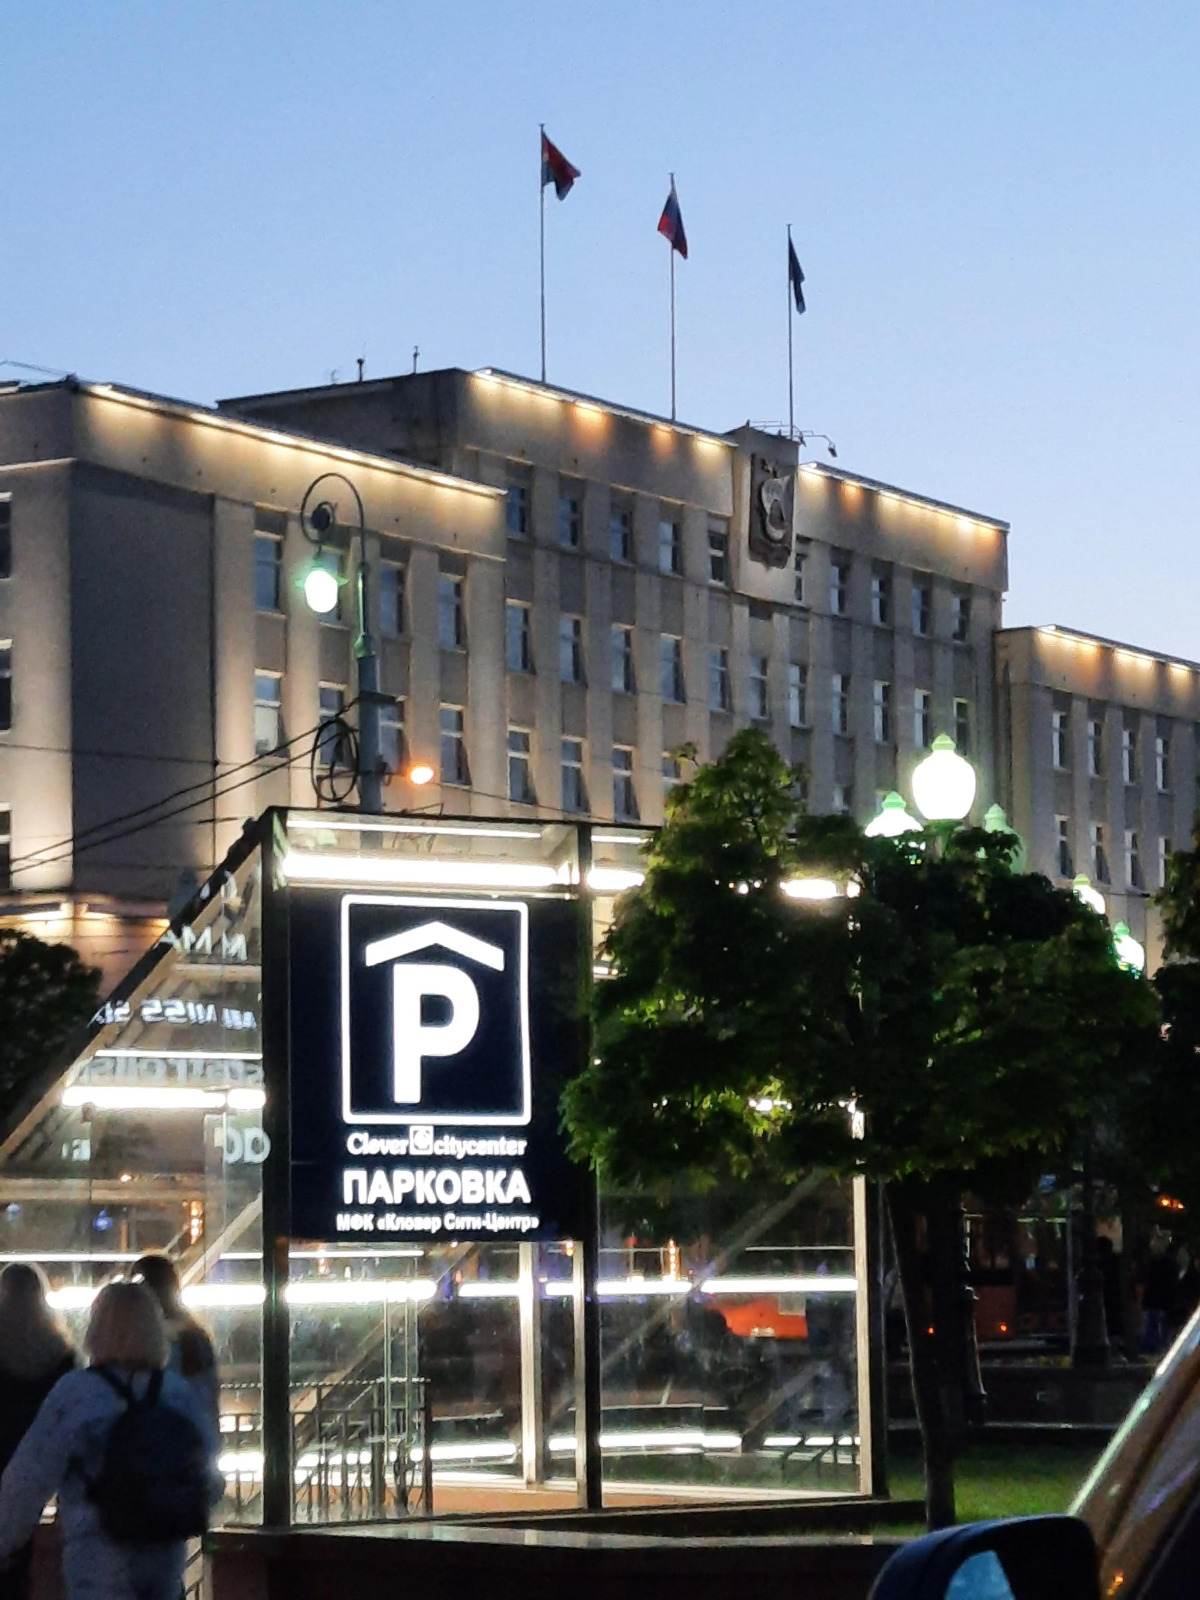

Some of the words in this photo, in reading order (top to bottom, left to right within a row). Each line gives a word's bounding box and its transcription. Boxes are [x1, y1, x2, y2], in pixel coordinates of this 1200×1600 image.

[393, 963, 480, 1104] P
[346, 1131, 409, 1156] Clever
[433, 1133, 528, 1160] citycenter
[342, 1168, 532, 1204] ПАРКОВКА
[336, 1213, 375, 1232] МФК
